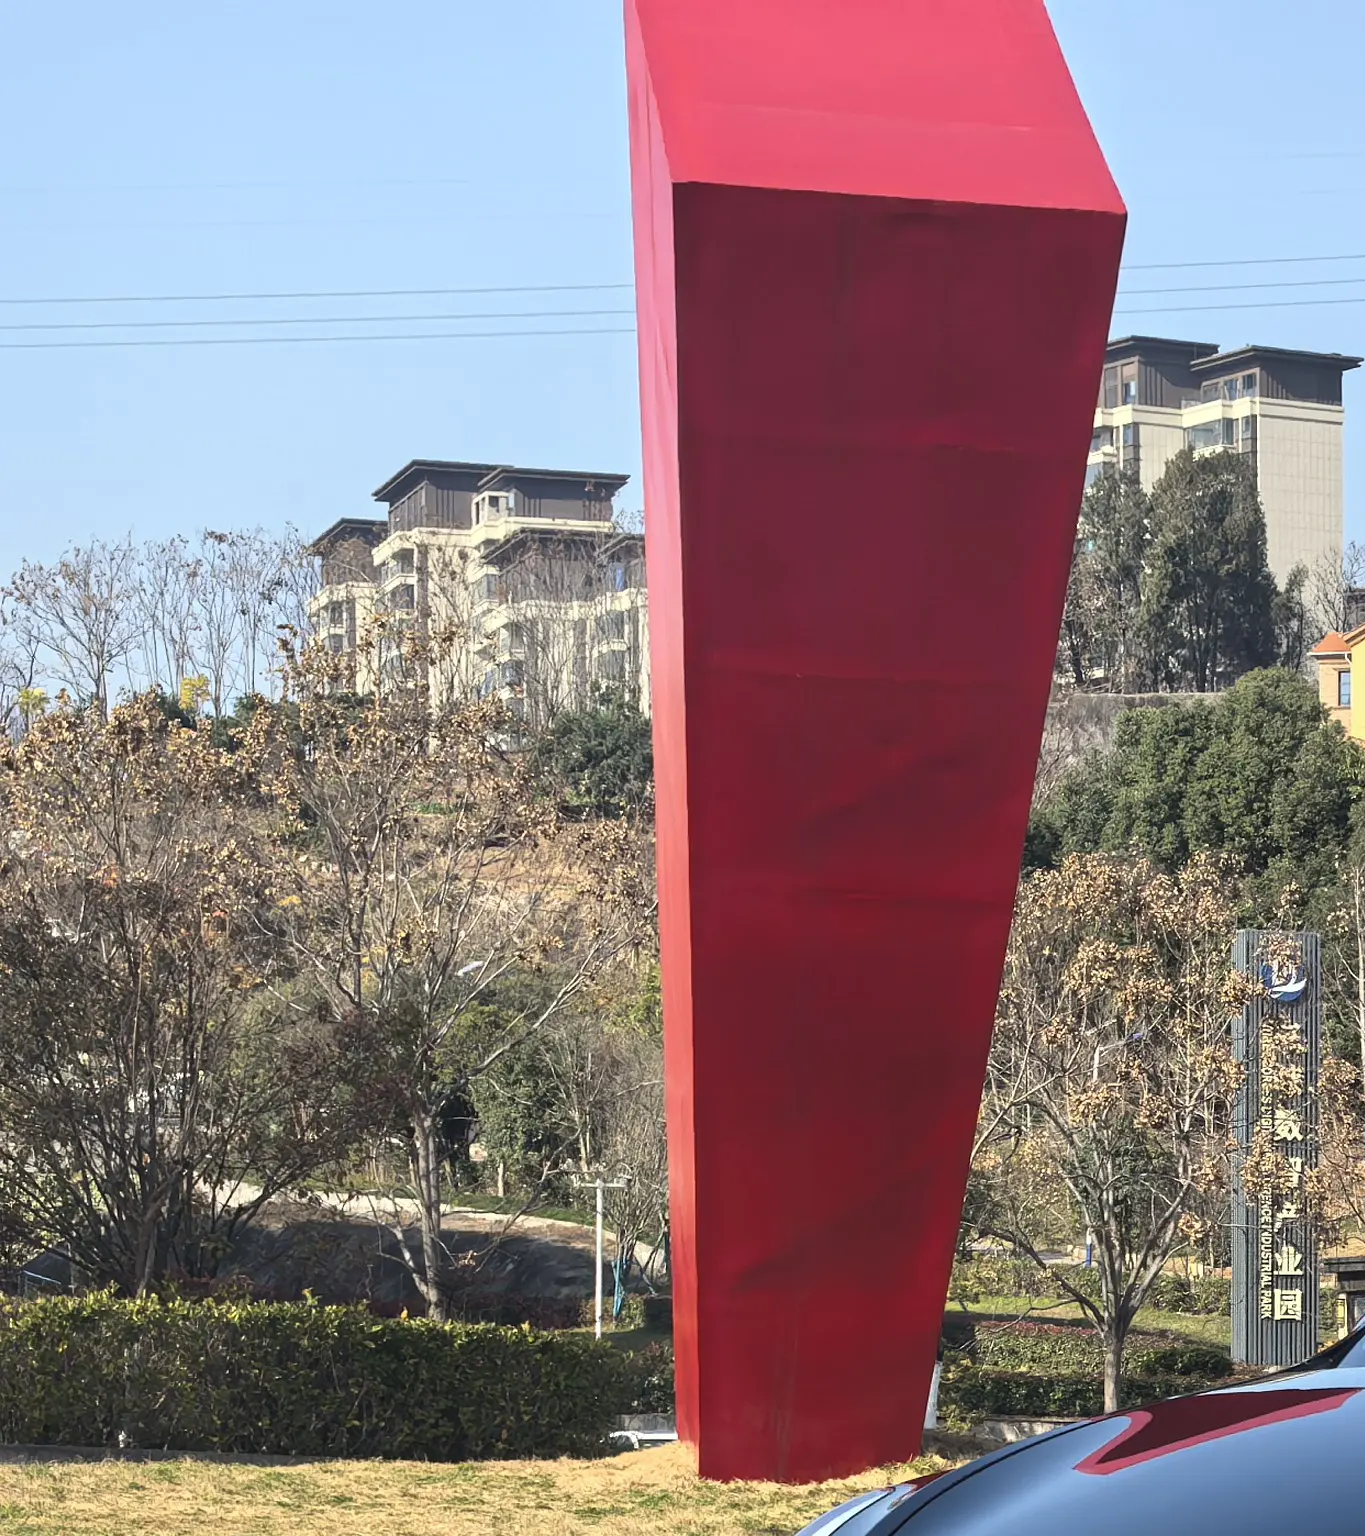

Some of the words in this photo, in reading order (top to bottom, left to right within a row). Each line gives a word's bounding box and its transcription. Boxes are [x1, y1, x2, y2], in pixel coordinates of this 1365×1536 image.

[1273, 1022, 1303, 1321] 数智产业园
[1260, 1225, 1273, 1288] INDUSTRIAL
[1260, 1290, 1273, 1319] PARK
